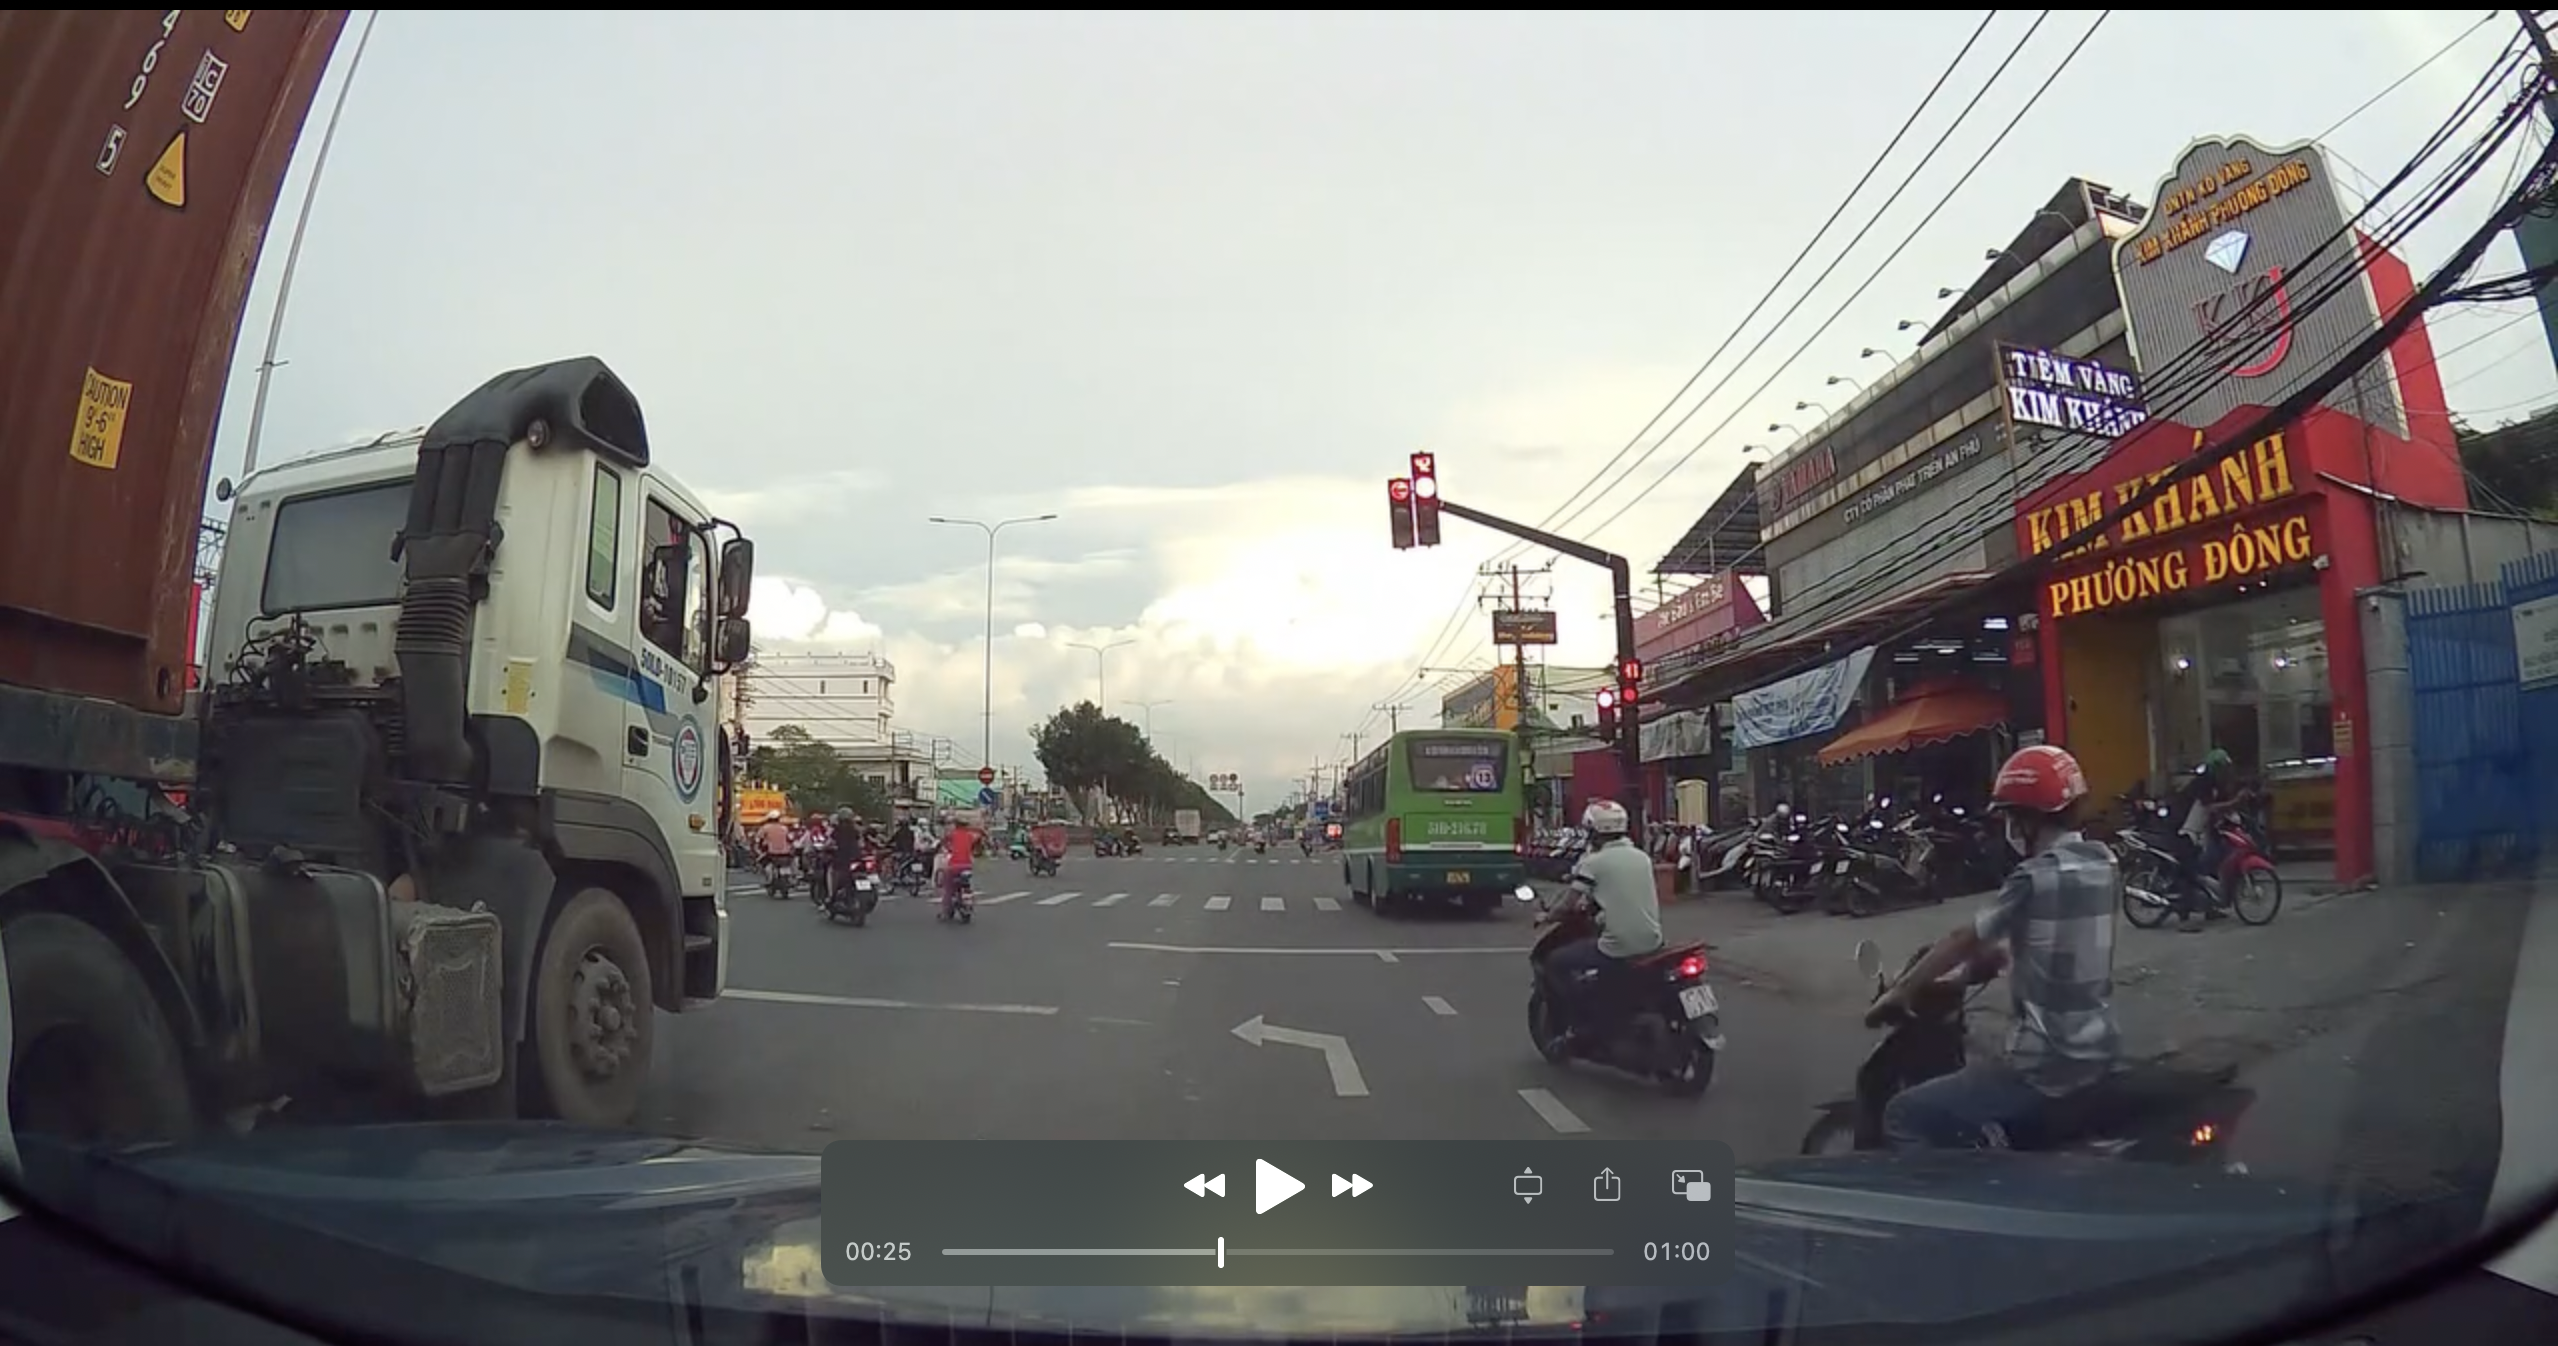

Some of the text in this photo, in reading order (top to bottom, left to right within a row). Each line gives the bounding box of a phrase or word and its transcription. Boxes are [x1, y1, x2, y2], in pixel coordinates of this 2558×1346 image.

[2134, 235, 2163, 266] KIM
[84, 373, 130, 410] CAUTION
[2011, 350, 2135, 400] TIỆM VÀNG
[2008, 386, 2063, 428] KIM
[78, 433, 107, 461] HIGH
[1944, 448, 1960, 470] AN
[1781, 445, 1836, 504] YAMAHA
[2027, 428, 2295, 563] KIM KHÁNH
[2050, 515, 2312, 618] PHƯƠNG ĐÔNG
